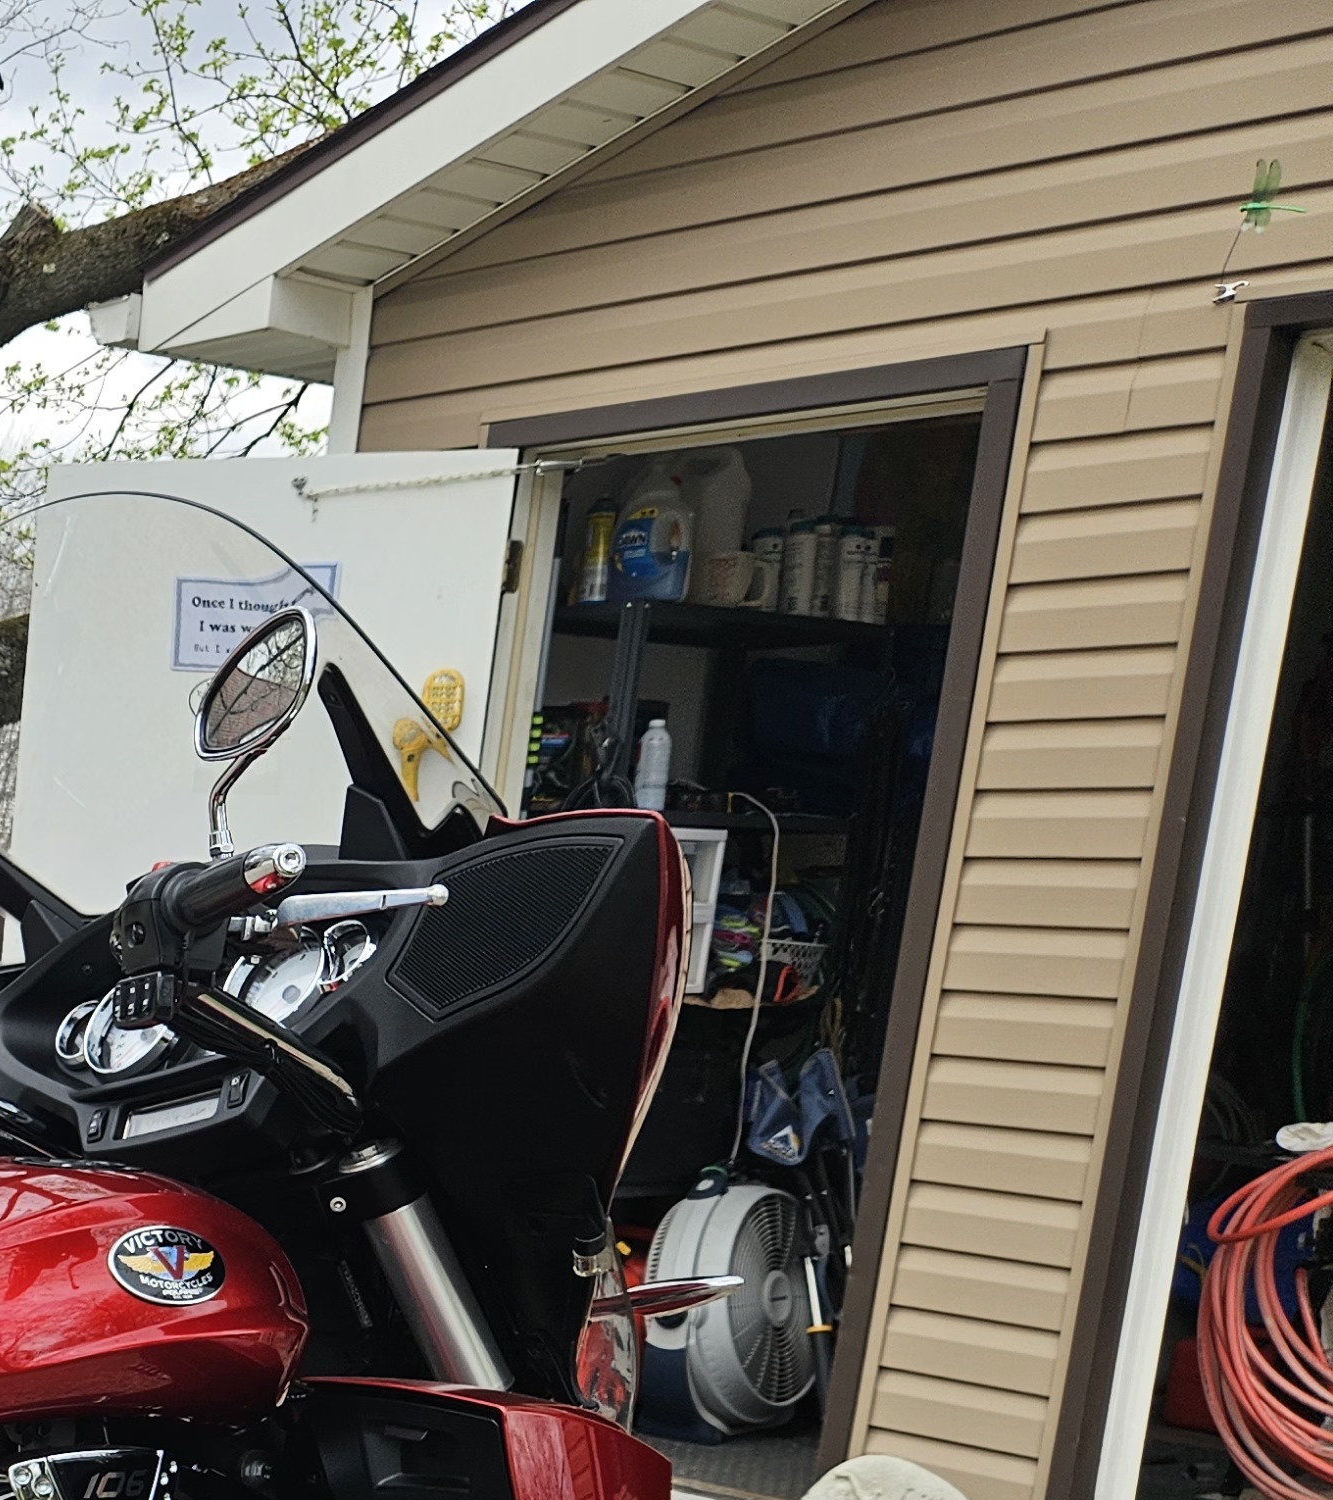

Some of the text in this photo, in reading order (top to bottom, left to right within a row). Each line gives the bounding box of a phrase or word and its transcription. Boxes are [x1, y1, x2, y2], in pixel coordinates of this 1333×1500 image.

[192, 596, 226, 609] Once
[229, 598, 234, 609] I
[199, 620, 205, 632] I
[209, 623, 236, 633] was
[122, 1230, 203, 1254] VICTORY
[139, 1272, 214, 1290] MOTORCYCLES
[83, 1469, 148, 1499] 106
